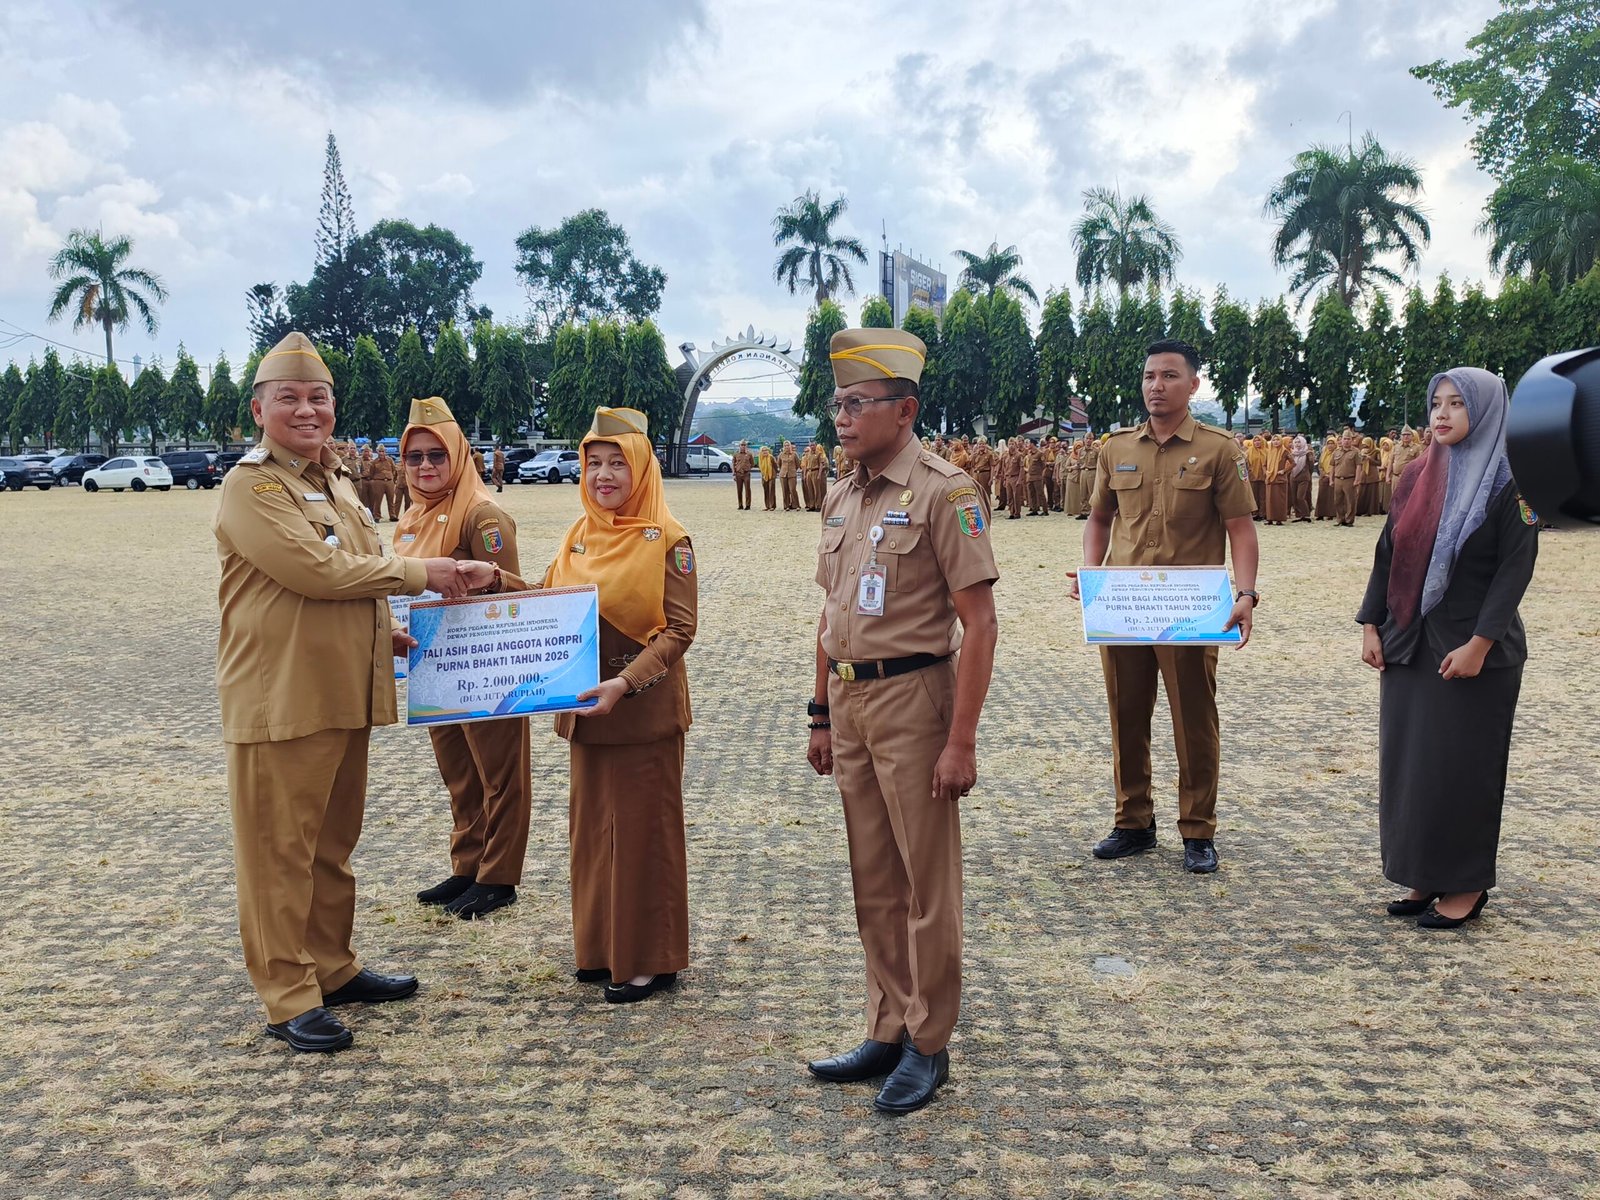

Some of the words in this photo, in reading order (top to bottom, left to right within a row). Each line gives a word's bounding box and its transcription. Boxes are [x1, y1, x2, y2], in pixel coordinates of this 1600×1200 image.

[447, 626, 467, 634] KORPS
[468, 624, 495, 632] PEGAWAI
[496, 621, 525, 629] REPUBLIK
[527, 618, 559, 626] INDONESIA
[1124, 616, 1142, 625] Rp.
[469, 630, 500, 638] PENGURUS
[531, 624, 559, 632] LAMPUNG
[423, 648, 443, 659] TALI
[445, 646, 468, 657] ASIH
[471, 643, 494, 654] BAGI
[496, 639, 542, 652] ANGGOTA
[544, 634, 583, 647] KORPRI
[436, 660, 470, 672] PURNA
[473, 657, 508, 669] BHAKTI
[510, 653, 542, 665] TAHUN
[545, 650, 569, 662] 2026
[457, 679, 478, 693] Rp.
[483, 672, 549, 688] 2.000.000,-
[459, 694, 482, 704] (DUA
[483, 692, 506, 702] JUTA
[507, 688, 546, 700] RUPIAH)
